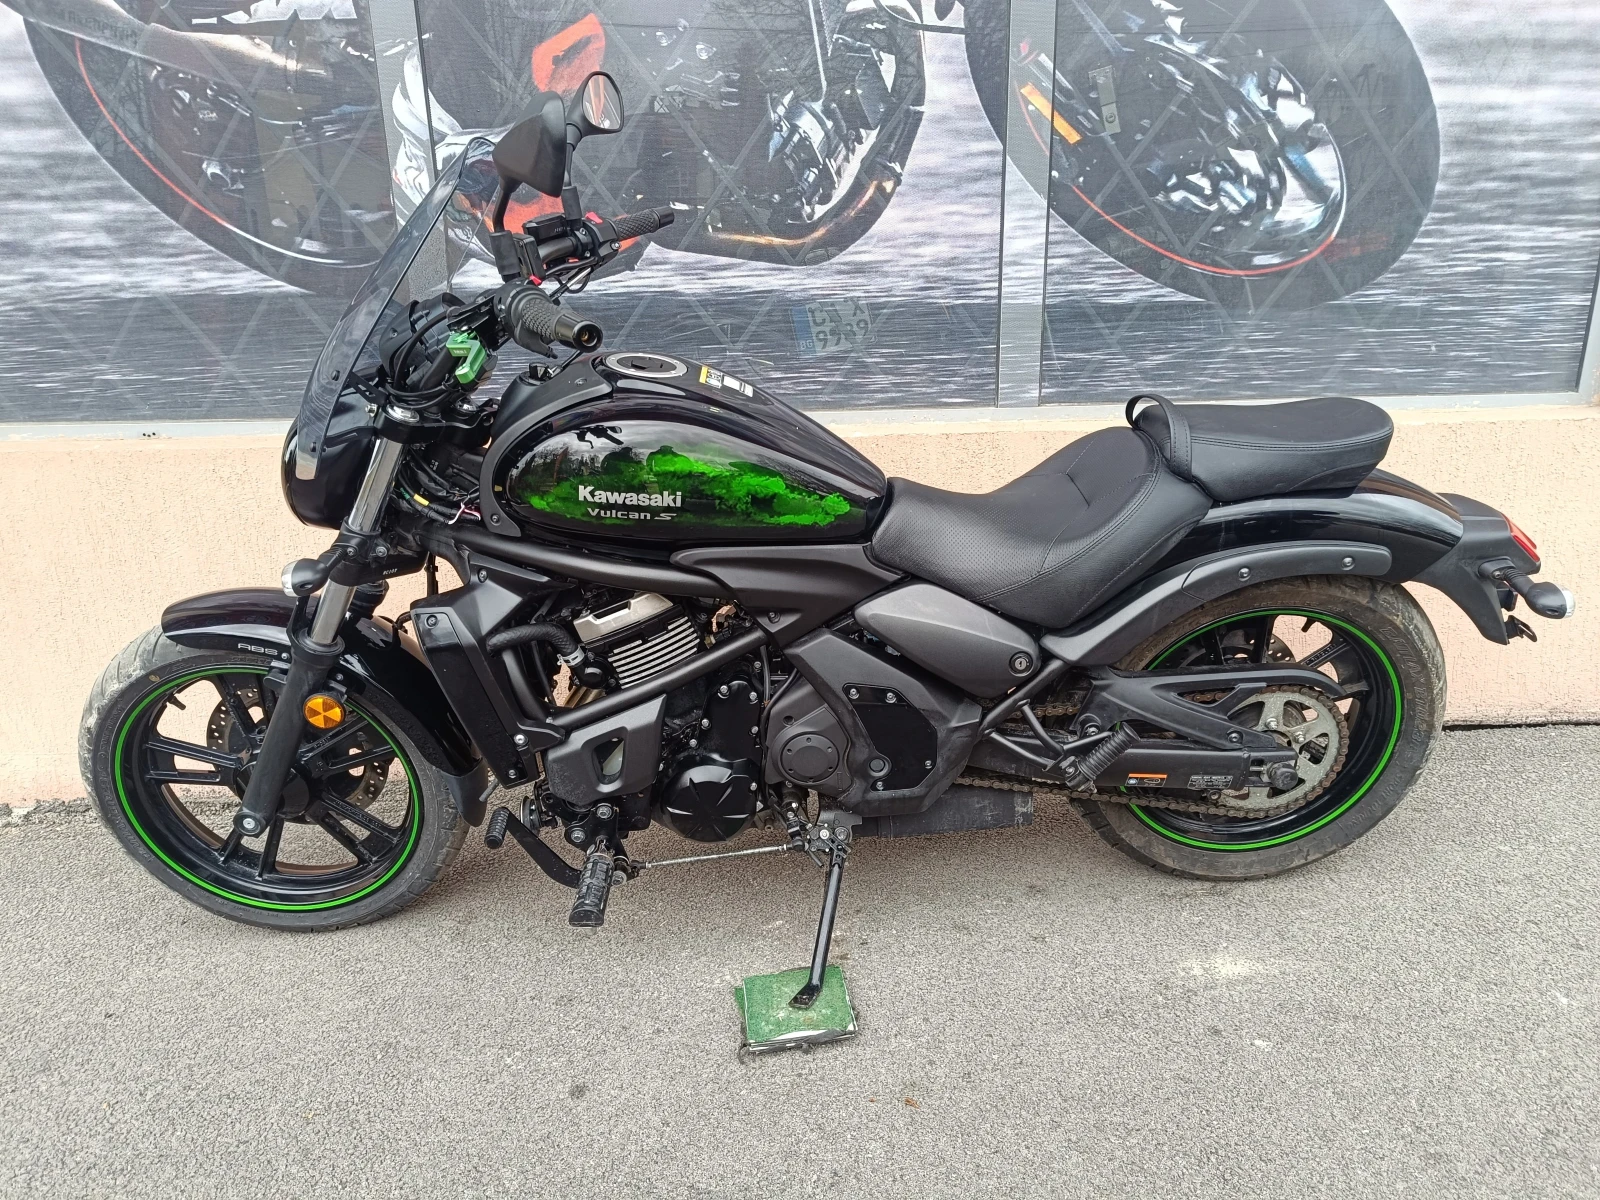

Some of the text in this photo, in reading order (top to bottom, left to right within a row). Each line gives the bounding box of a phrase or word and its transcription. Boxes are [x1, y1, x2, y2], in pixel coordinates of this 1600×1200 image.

[799, 340, 813, 350] BG
[578, 485, 682, 507] Kawasaki
[587, 507, 678, 521] Vulcan S
[237, 643, 278, 656] ABS
